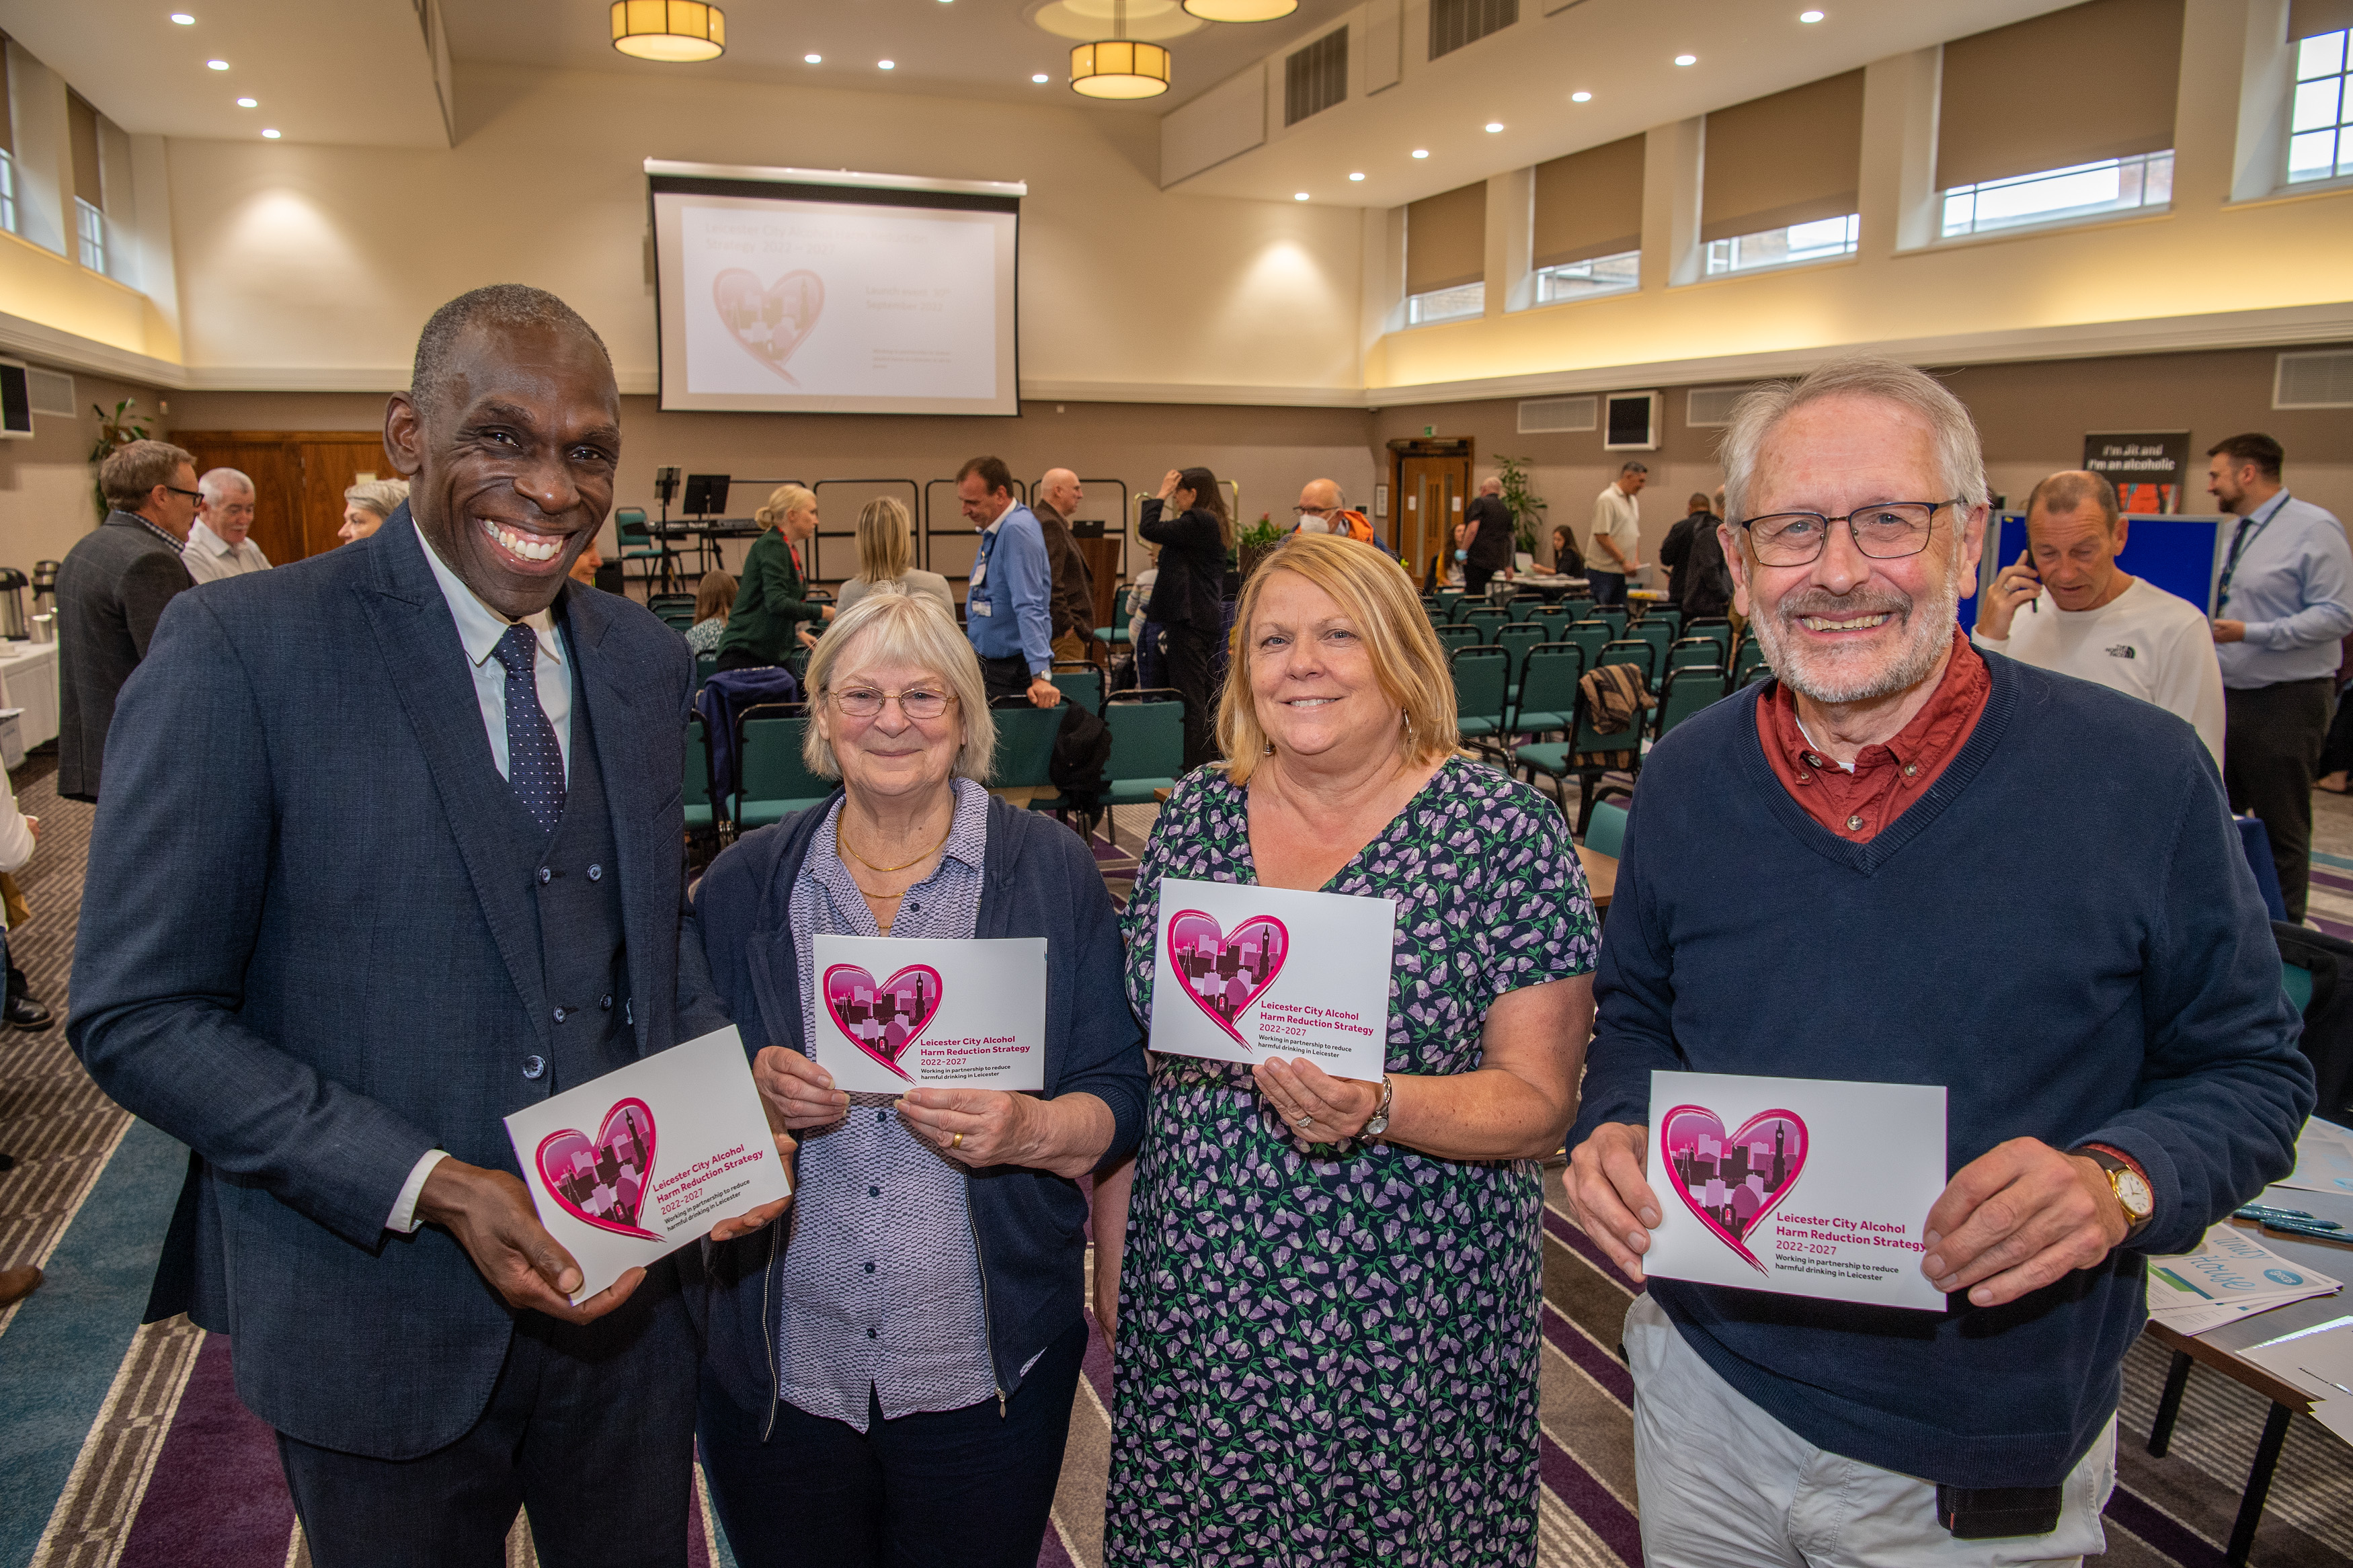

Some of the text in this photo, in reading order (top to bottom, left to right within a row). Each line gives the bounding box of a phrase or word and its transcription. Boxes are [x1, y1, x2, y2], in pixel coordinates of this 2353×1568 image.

[2140, 444, 2163, 456] and
[2087, 458, 2176, 470] I'm an alcoholic
[1261, 1000, 1359, 1020] Leicester City Alcohol
[1259, 1023, 1307, 1036] 2022-2027
[1260, 1012, 1374, 1036] Harm Reduction Strategy
[947, 1046, 991, 1055] Reduction
[992, 1045, 1031, 1053] Strategy
[962, 1038, 982, 1046] City
[983, 1036, 1016, 1044] Alcohol
[1258, 1042, 1281, 1050] harmful
[1281, 1044, 1305, 1054] drinking
[1312, 1049, 1339, 1058] Leicester
[1259, 1034, 1283, 1044] Working
[1289, 1038, 1324, 1050] partnership
[1332, 1044, 1352, 1053] reduce
[920, 1058, 967, 1066] 2022-2027
[951, 1066, 984, 1074] partnership
[653, 1143, 745, 1192] Leicester City Alcohol
[656, 1150, 763, 1204] Harm Reduction Strategy
[661, 1188, 703, 1215] 2022-2027
[664, 1209, 687, 1224] Working
[692, 1191, 723, 1210] partnership
[731, 1180, 750, 1191] reduce
[667, 1219, 688, 1232] harmful
[688, 1206, 710, 1221] drinking
[715, 1191, 741, 1206] Leicester
[1777, 1212, 1905, 1234] Leicester City Alcohol
[1776, 1225, 1926, 1252] Harm Reduction Strategy
[1776, 1240, 1837, 1255] 2022-2027
[2213, 1237, 2273, 1259] Unity
[1776, 1253, 1806, 1265] Working
[1816, 1258, 1860, 1270] partnership
[1872, 1264, 1899, 1274] reduce
[1776, 1262, 1804, 1272] harmful
[1806, 1266, 1837, 1278] drinking
[1846, 1270, 1882, 1281] Leicester
[2184, 1255, 2256, 1290] House
